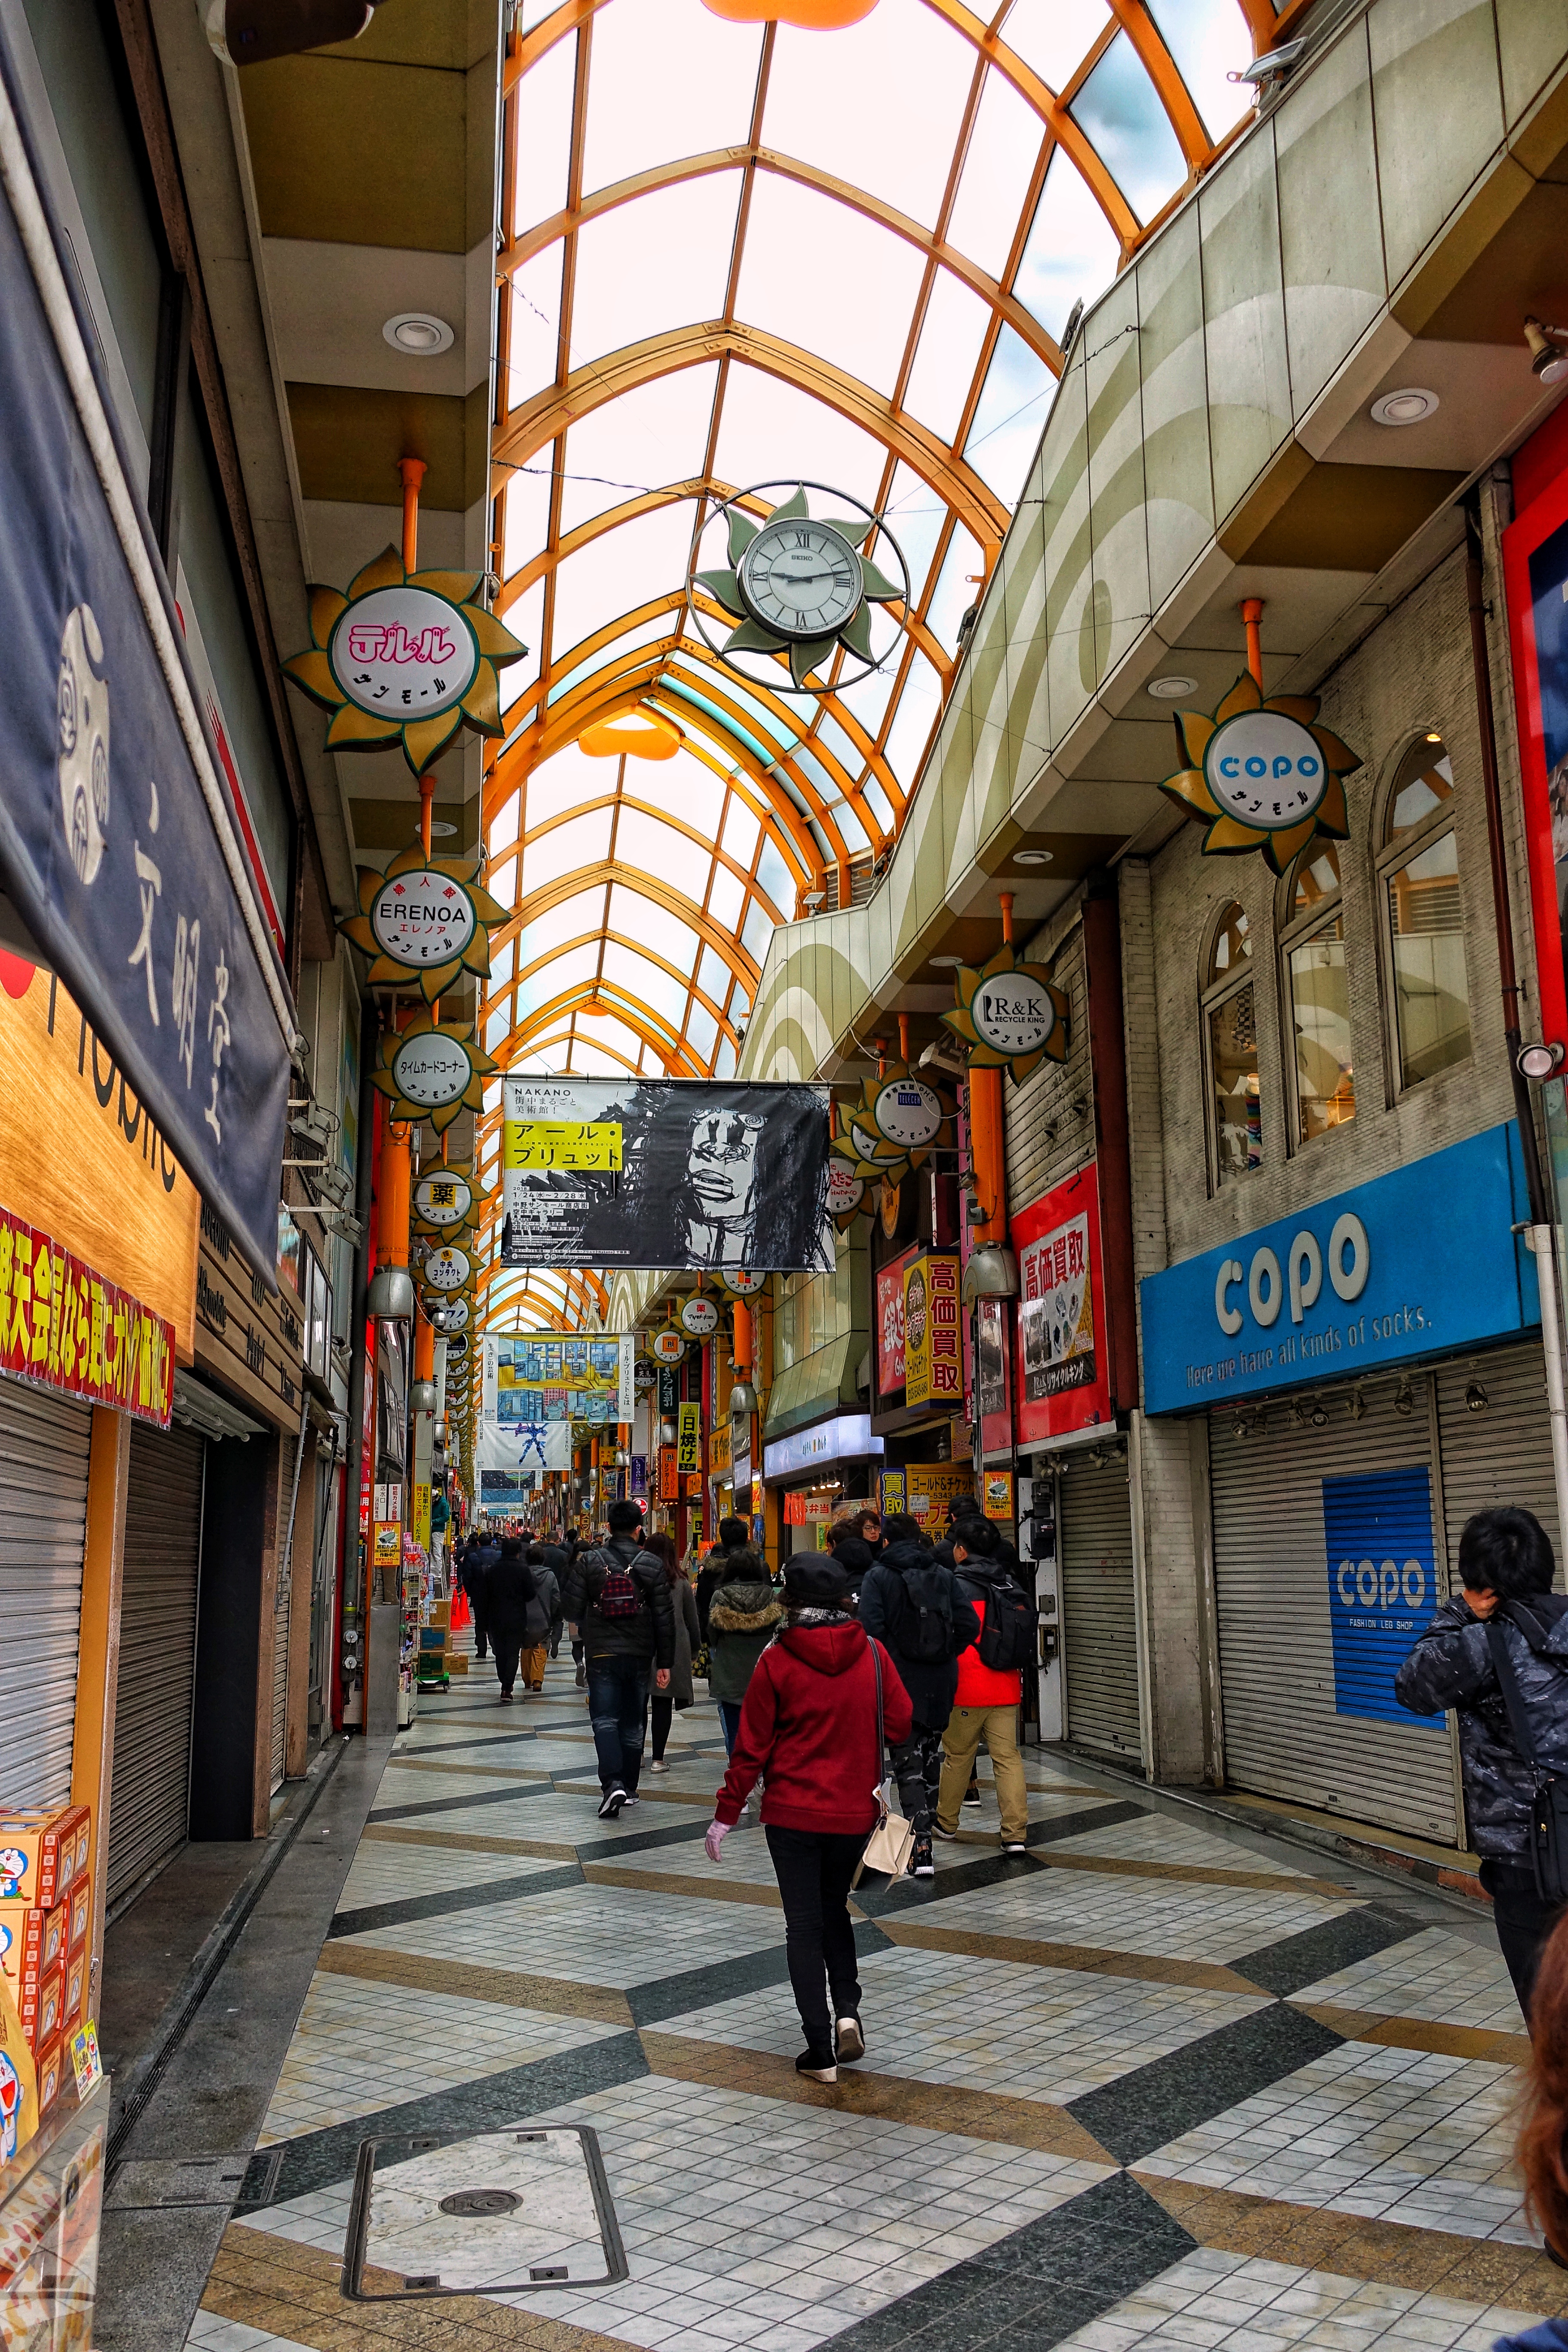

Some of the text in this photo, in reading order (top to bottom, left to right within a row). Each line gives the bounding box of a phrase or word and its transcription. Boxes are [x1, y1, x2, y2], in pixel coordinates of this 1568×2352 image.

[349, 625, 456, 664] テルル
[353, 673, 446, 704] サンモール
[1231, 790, 1308, 815] サンモール
[380, 903, 466, 924] ERENOA
[399, 923, 447, 935] エレノア
[387, 934, 453, 958] サンモール
[995, 997, 1044, 1016] R&K
[989, 1027, 1041, 1045] サンモール
[400, 1061, 465, 1074] タイムカードコーナー
[407, 1082, 456, 1099] サンモール
[515, 1088, 571, 1096] NAKANO
[515, 1096, 577, 1106] 街中まるごと
[888, 1124, 931, 1140] サンモール
[513, 1146, 619, 1167] ブリュット
[432, 1185, 453, 1205] 薬
[423, 1208, 459, 1221] サンモール
[1025, 1229, 1085, 1301] 高価買取
[432, 1277, 461, 1287] サンモール
[729, 1280, 757, 1291] サンモール
[696, 1304, 706, 1313] 薬
[688, 1323, 711, 1332] サンモール
[929, 1262, 959, 1392] 高価買取
[1186, 1364, 1213, 1388] Here
[1217, 1357, 1236, 1380] we
[1278, 1335, 1295, 1365] all
[1300, 1325, 1341, 1359] kinds
[1348, 1315, 1365, 1347] of
[1372, 1304, 1432, 1341] socks.
[680, 1416, 697, 1462] 日焼け
[912, 1476, 974, 1491] ゴールド&チケット
[883, 1473, 904, 1516] 買取
[1349, 1618, 1413, 1630] FASHION LEG SHOP
